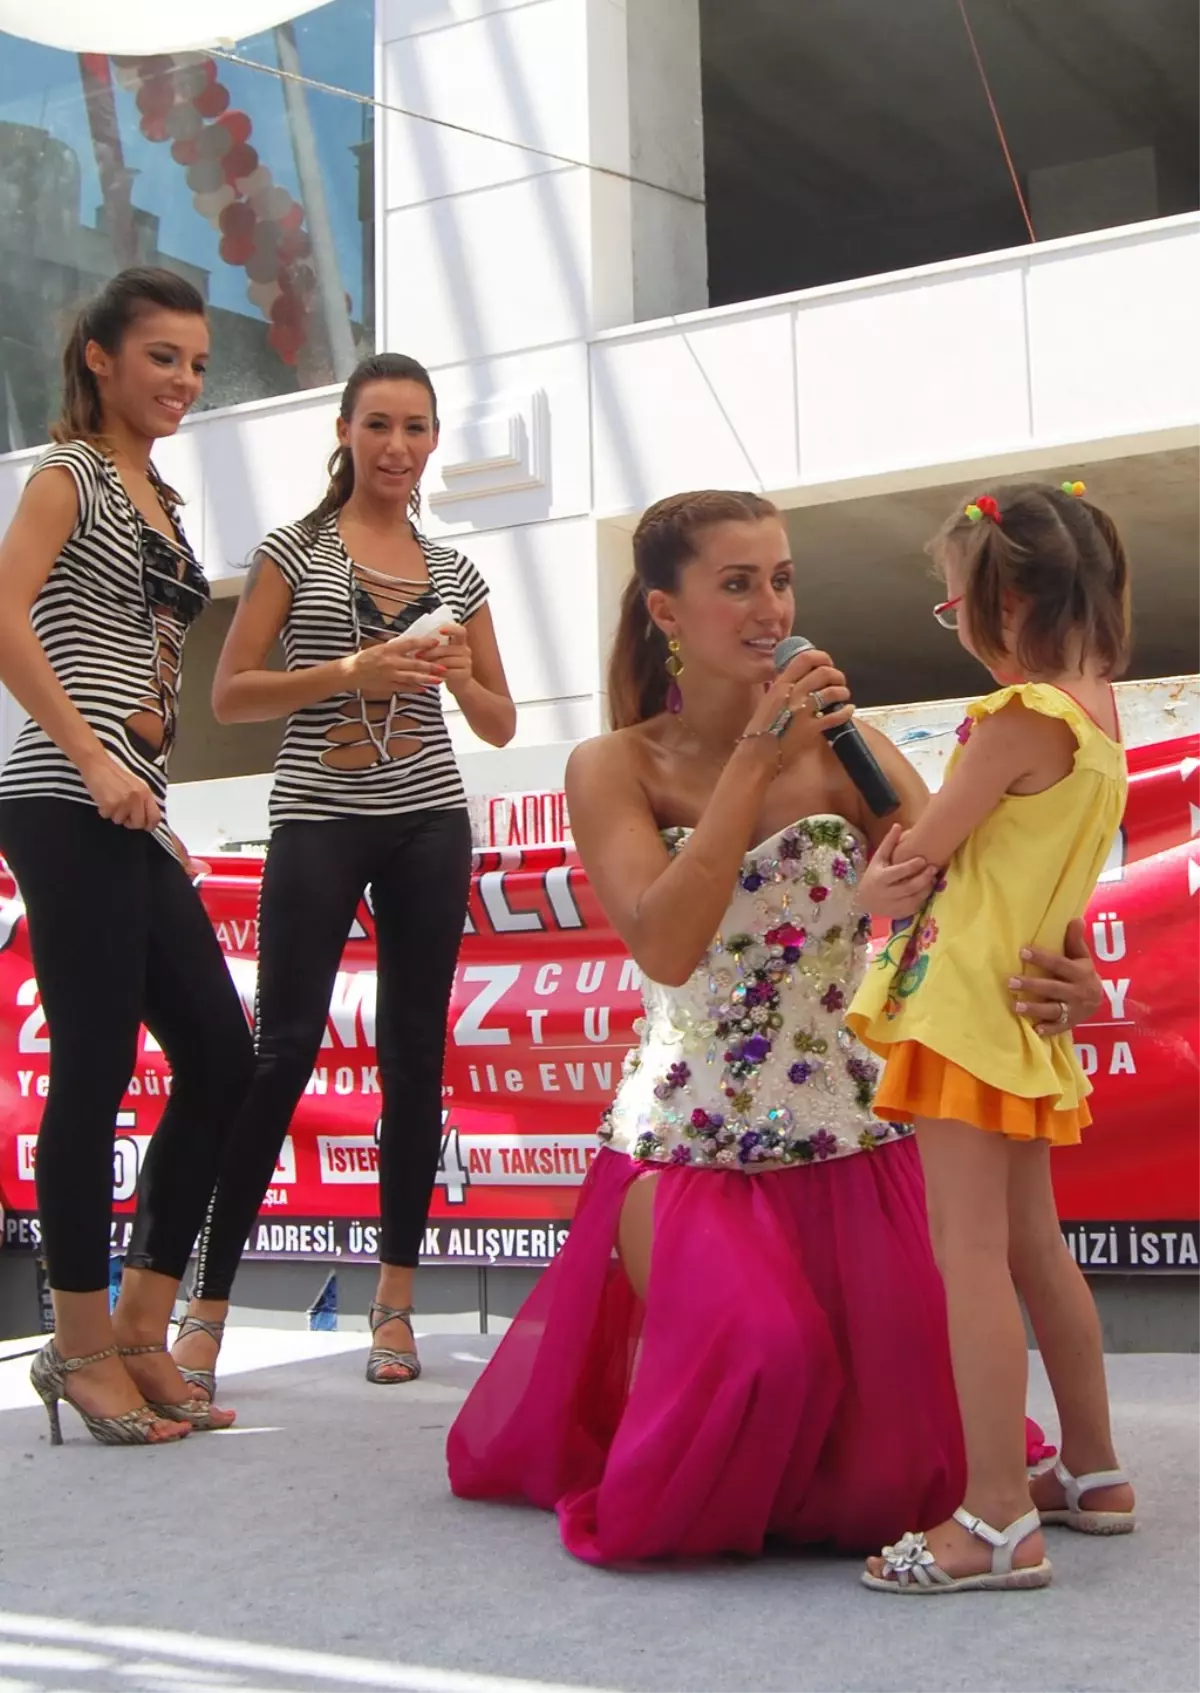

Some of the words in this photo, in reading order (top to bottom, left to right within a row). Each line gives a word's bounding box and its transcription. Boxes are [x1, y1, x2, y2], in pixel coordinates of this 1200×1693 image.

[469, 1064, 525, 1093] ile
[469, 1148, 493, 1174] AY
[256, 1220, 342, 1257] ADRESİ,
